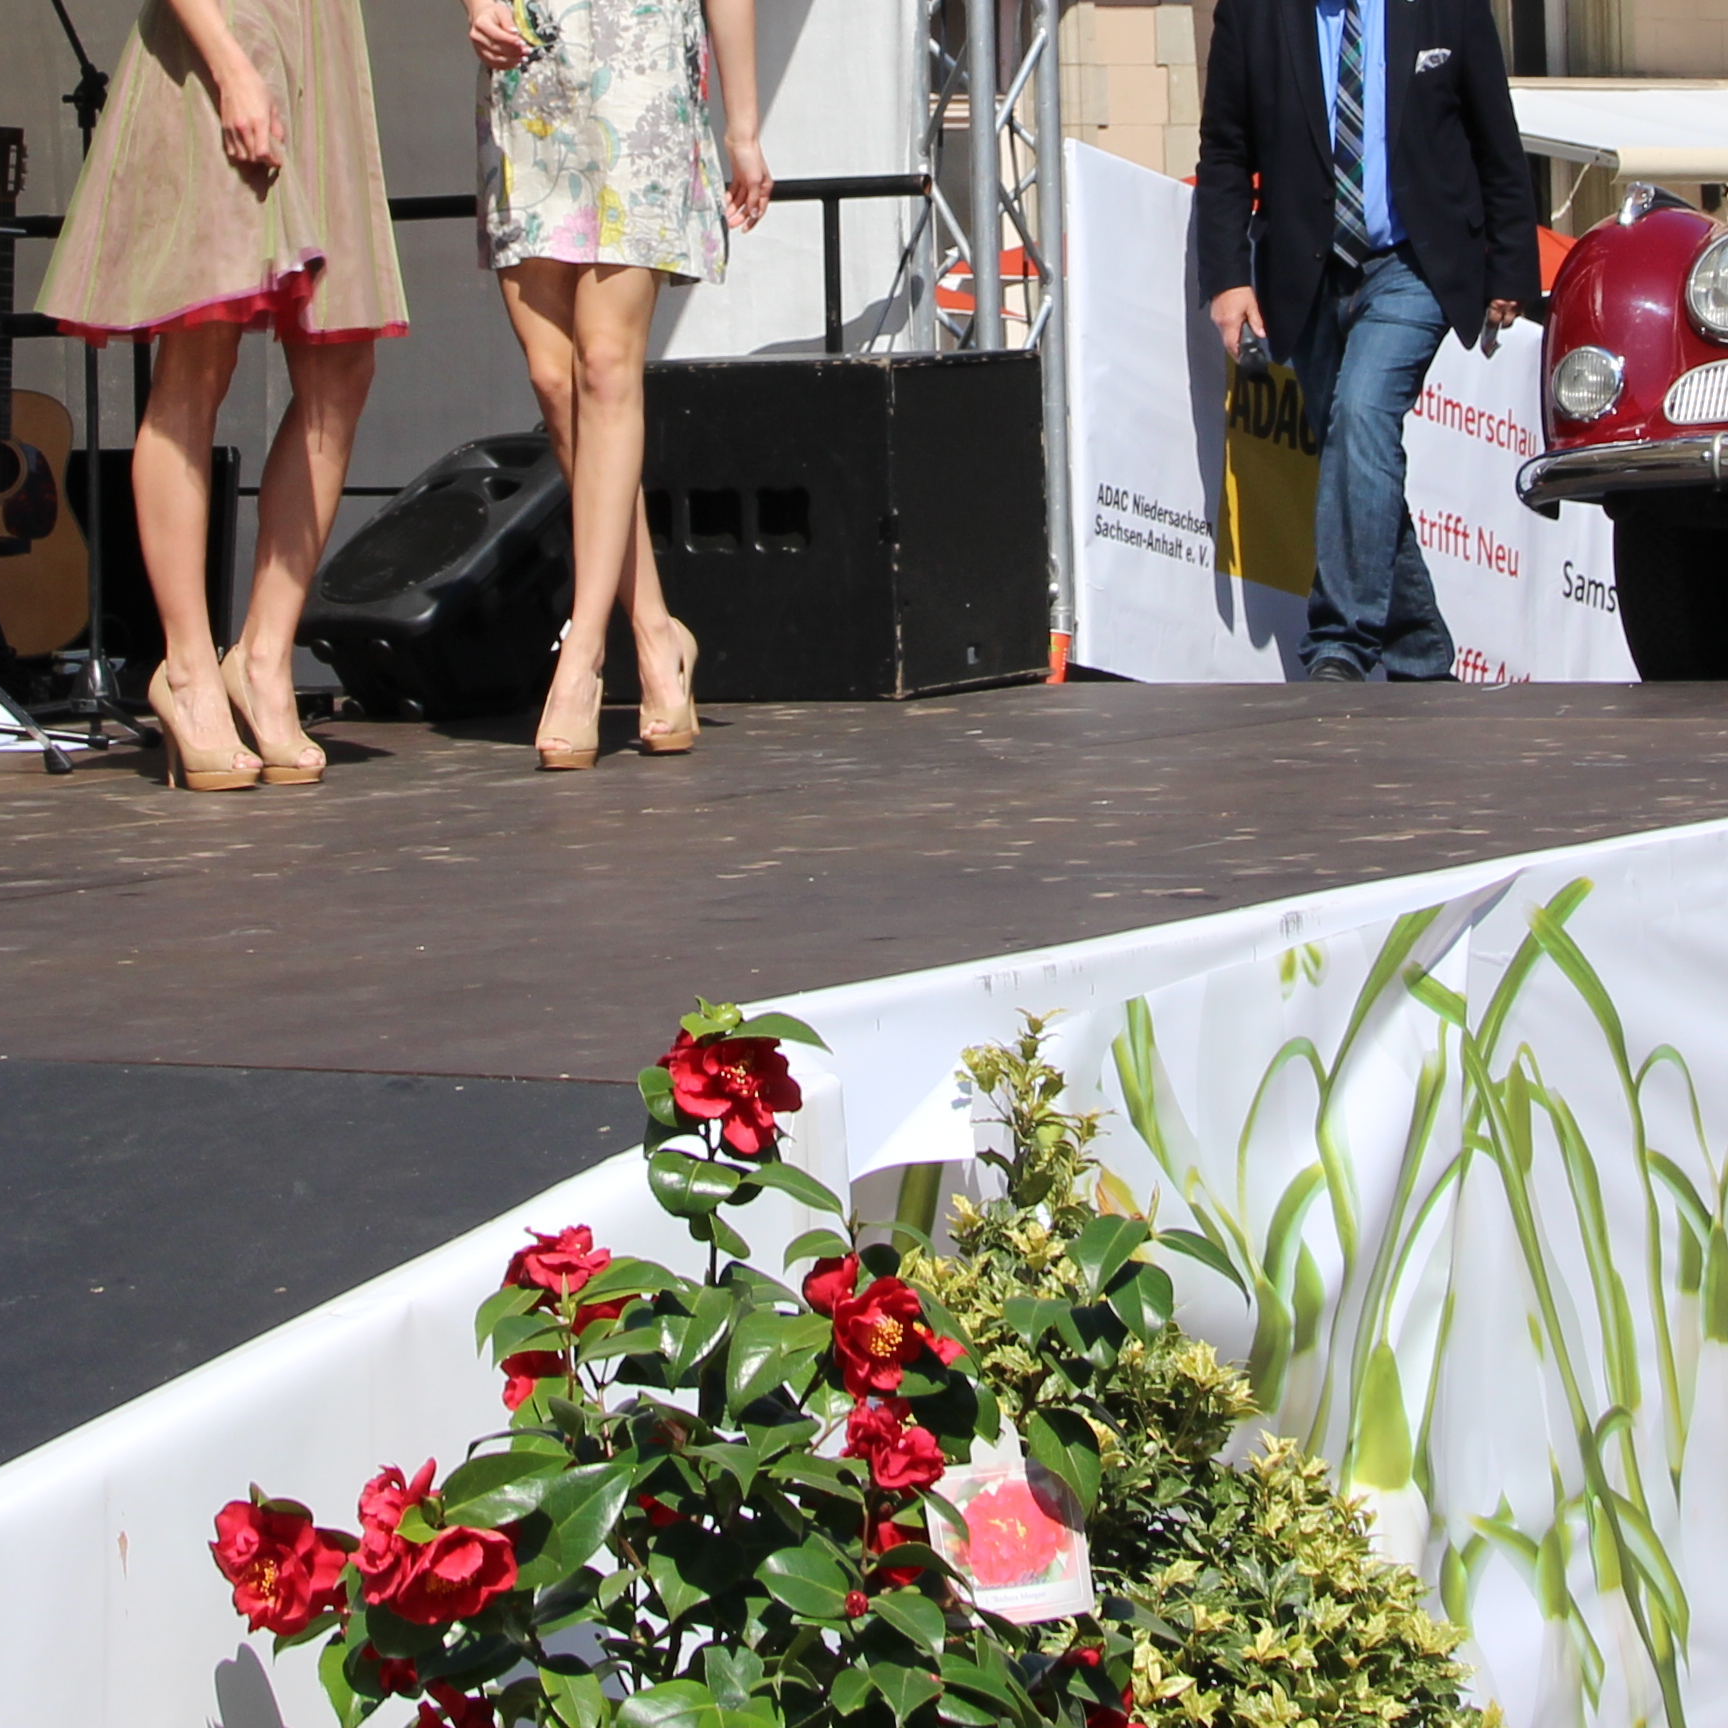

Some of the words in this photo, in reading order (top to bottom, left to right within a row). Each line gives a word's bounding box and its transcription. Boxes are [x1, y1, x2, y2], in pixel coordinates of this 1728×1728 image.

[1094, 514, 1183, 561] Sachsen-Anhalt
[1096, 483, 1129, 513] ADAC
[1132, 493, 1214, 538] Niedersachsen
[1418, 509, 1471, 562] trifft
[1476, 526, 1519, 579] Neu
[1562, 560, 1617, 614] Sams
